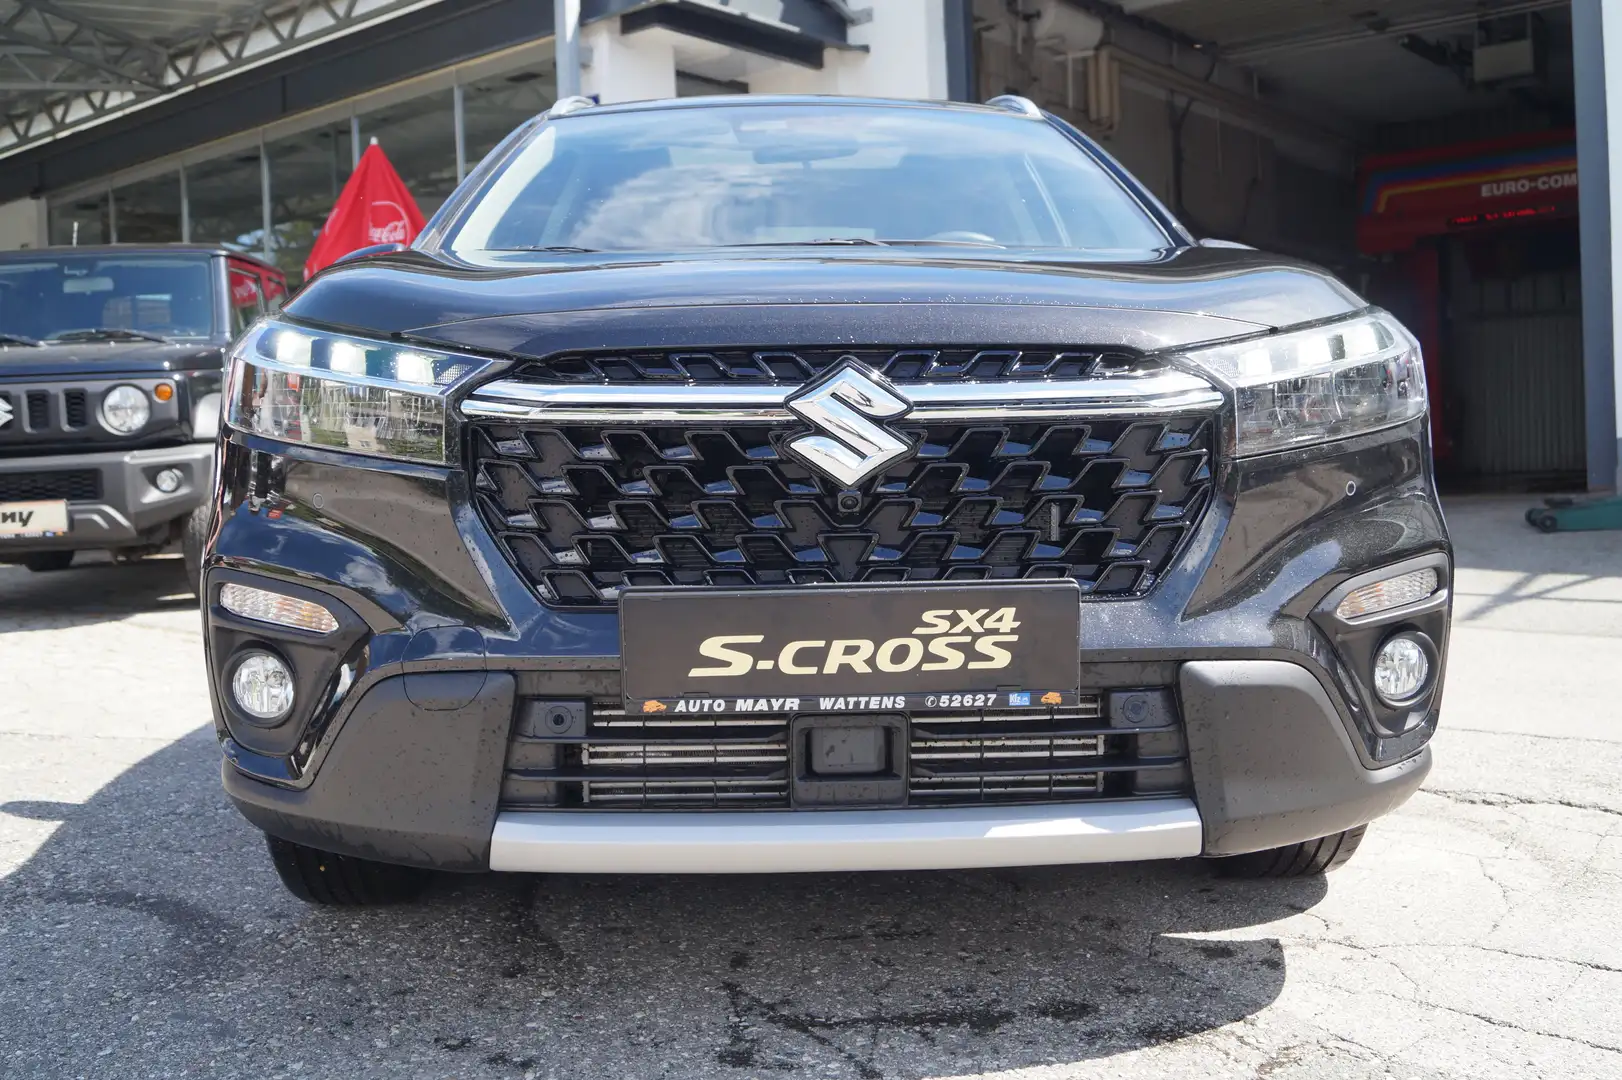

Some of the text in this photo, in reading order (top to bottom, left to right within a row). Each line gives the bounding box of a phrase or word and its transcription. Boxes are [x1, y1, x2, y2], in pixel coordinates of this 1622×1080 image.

[912, 607, 1021, 634] SX4
[688, 635, 1019, 677] S-CROSS
[674, 694, 997, 712] AUTO MAYR WATTENS 52627
